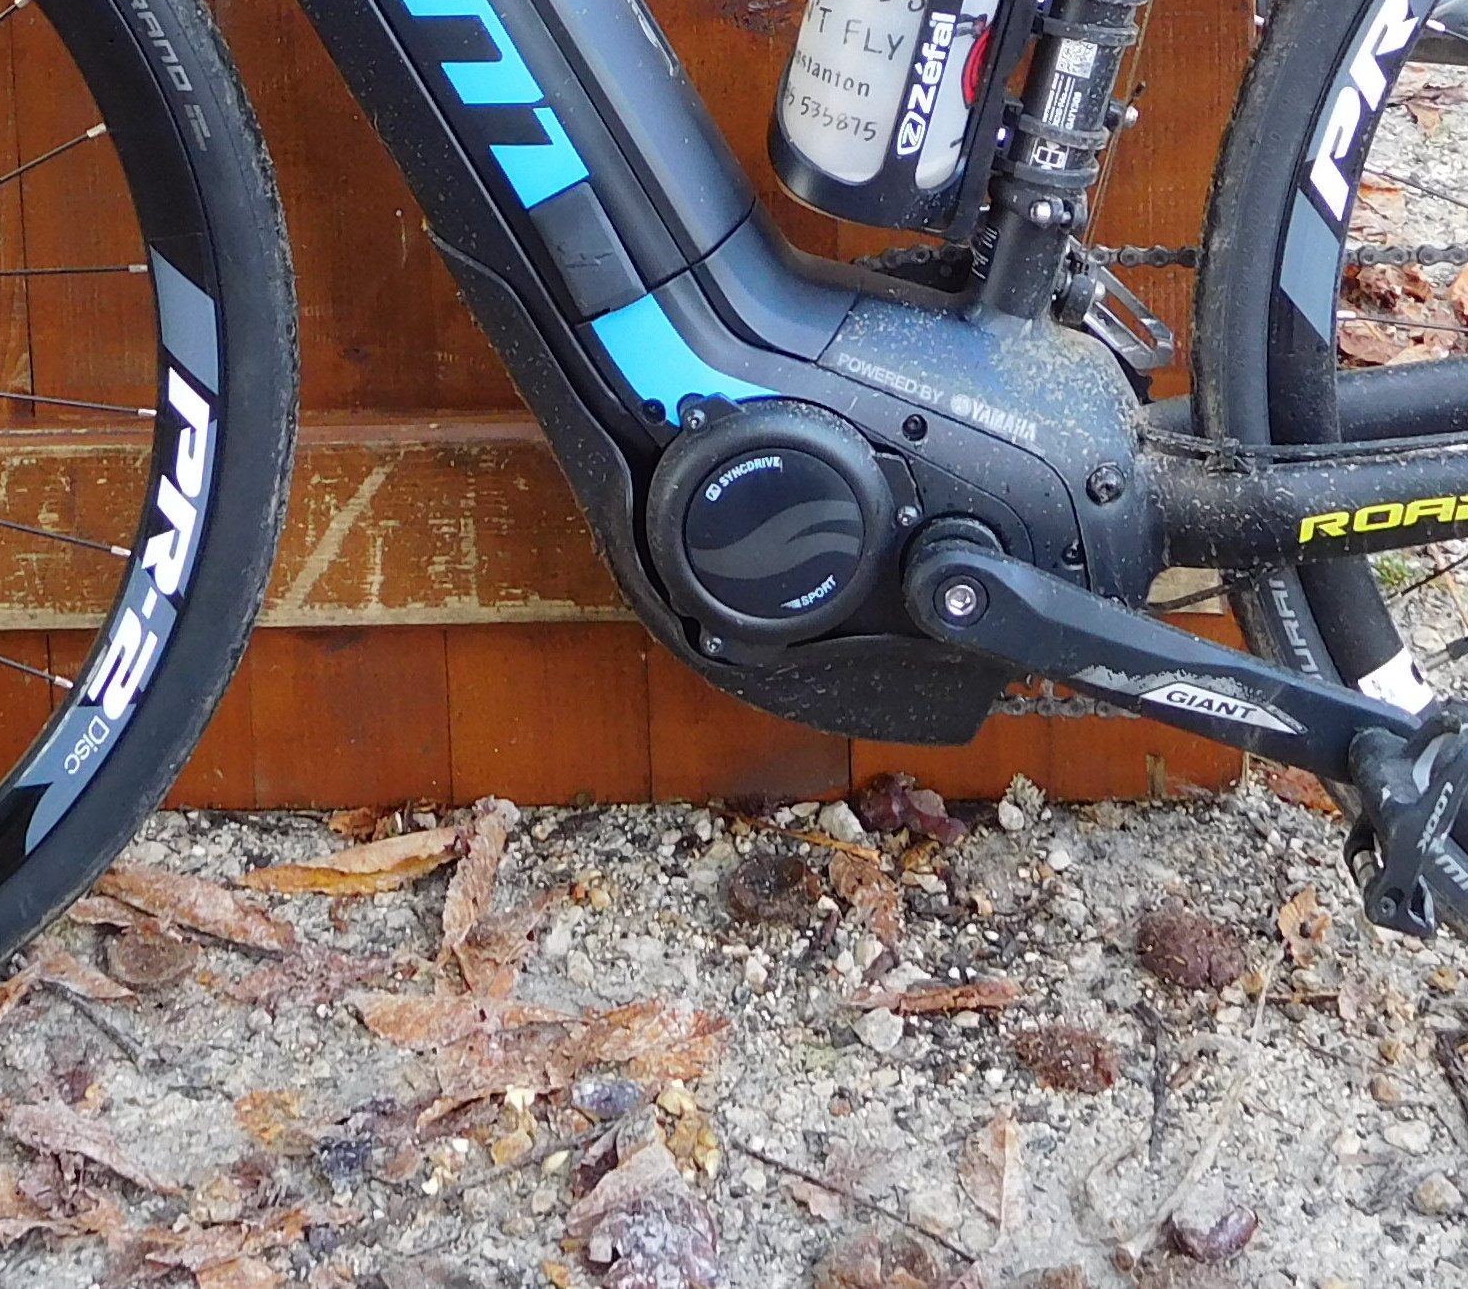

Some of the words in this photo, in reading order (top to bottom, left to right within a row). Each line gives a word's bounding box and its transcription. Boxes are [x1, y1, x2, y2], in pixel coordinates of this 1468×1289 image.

[843, 19, 905, 60] FLY
[908, 12, 957, 114] Zéfal
[801, 97, 878, 141] 535875
[838, 353, 917, 394] POWERED
[920, 385, 944, 404] BY
[972, 397, 1037, 440] YAMAHA
[719, 456, 781, 487] SYNCDRIVE
[86, 366, 210, 720] PR-2
[801, 574, 837, 606] SPORT
[1166, 690, 1257, 720] GIANT
[63, 722, 112, 776] Disc
[1417, 781, 1453, 854] LOOK
